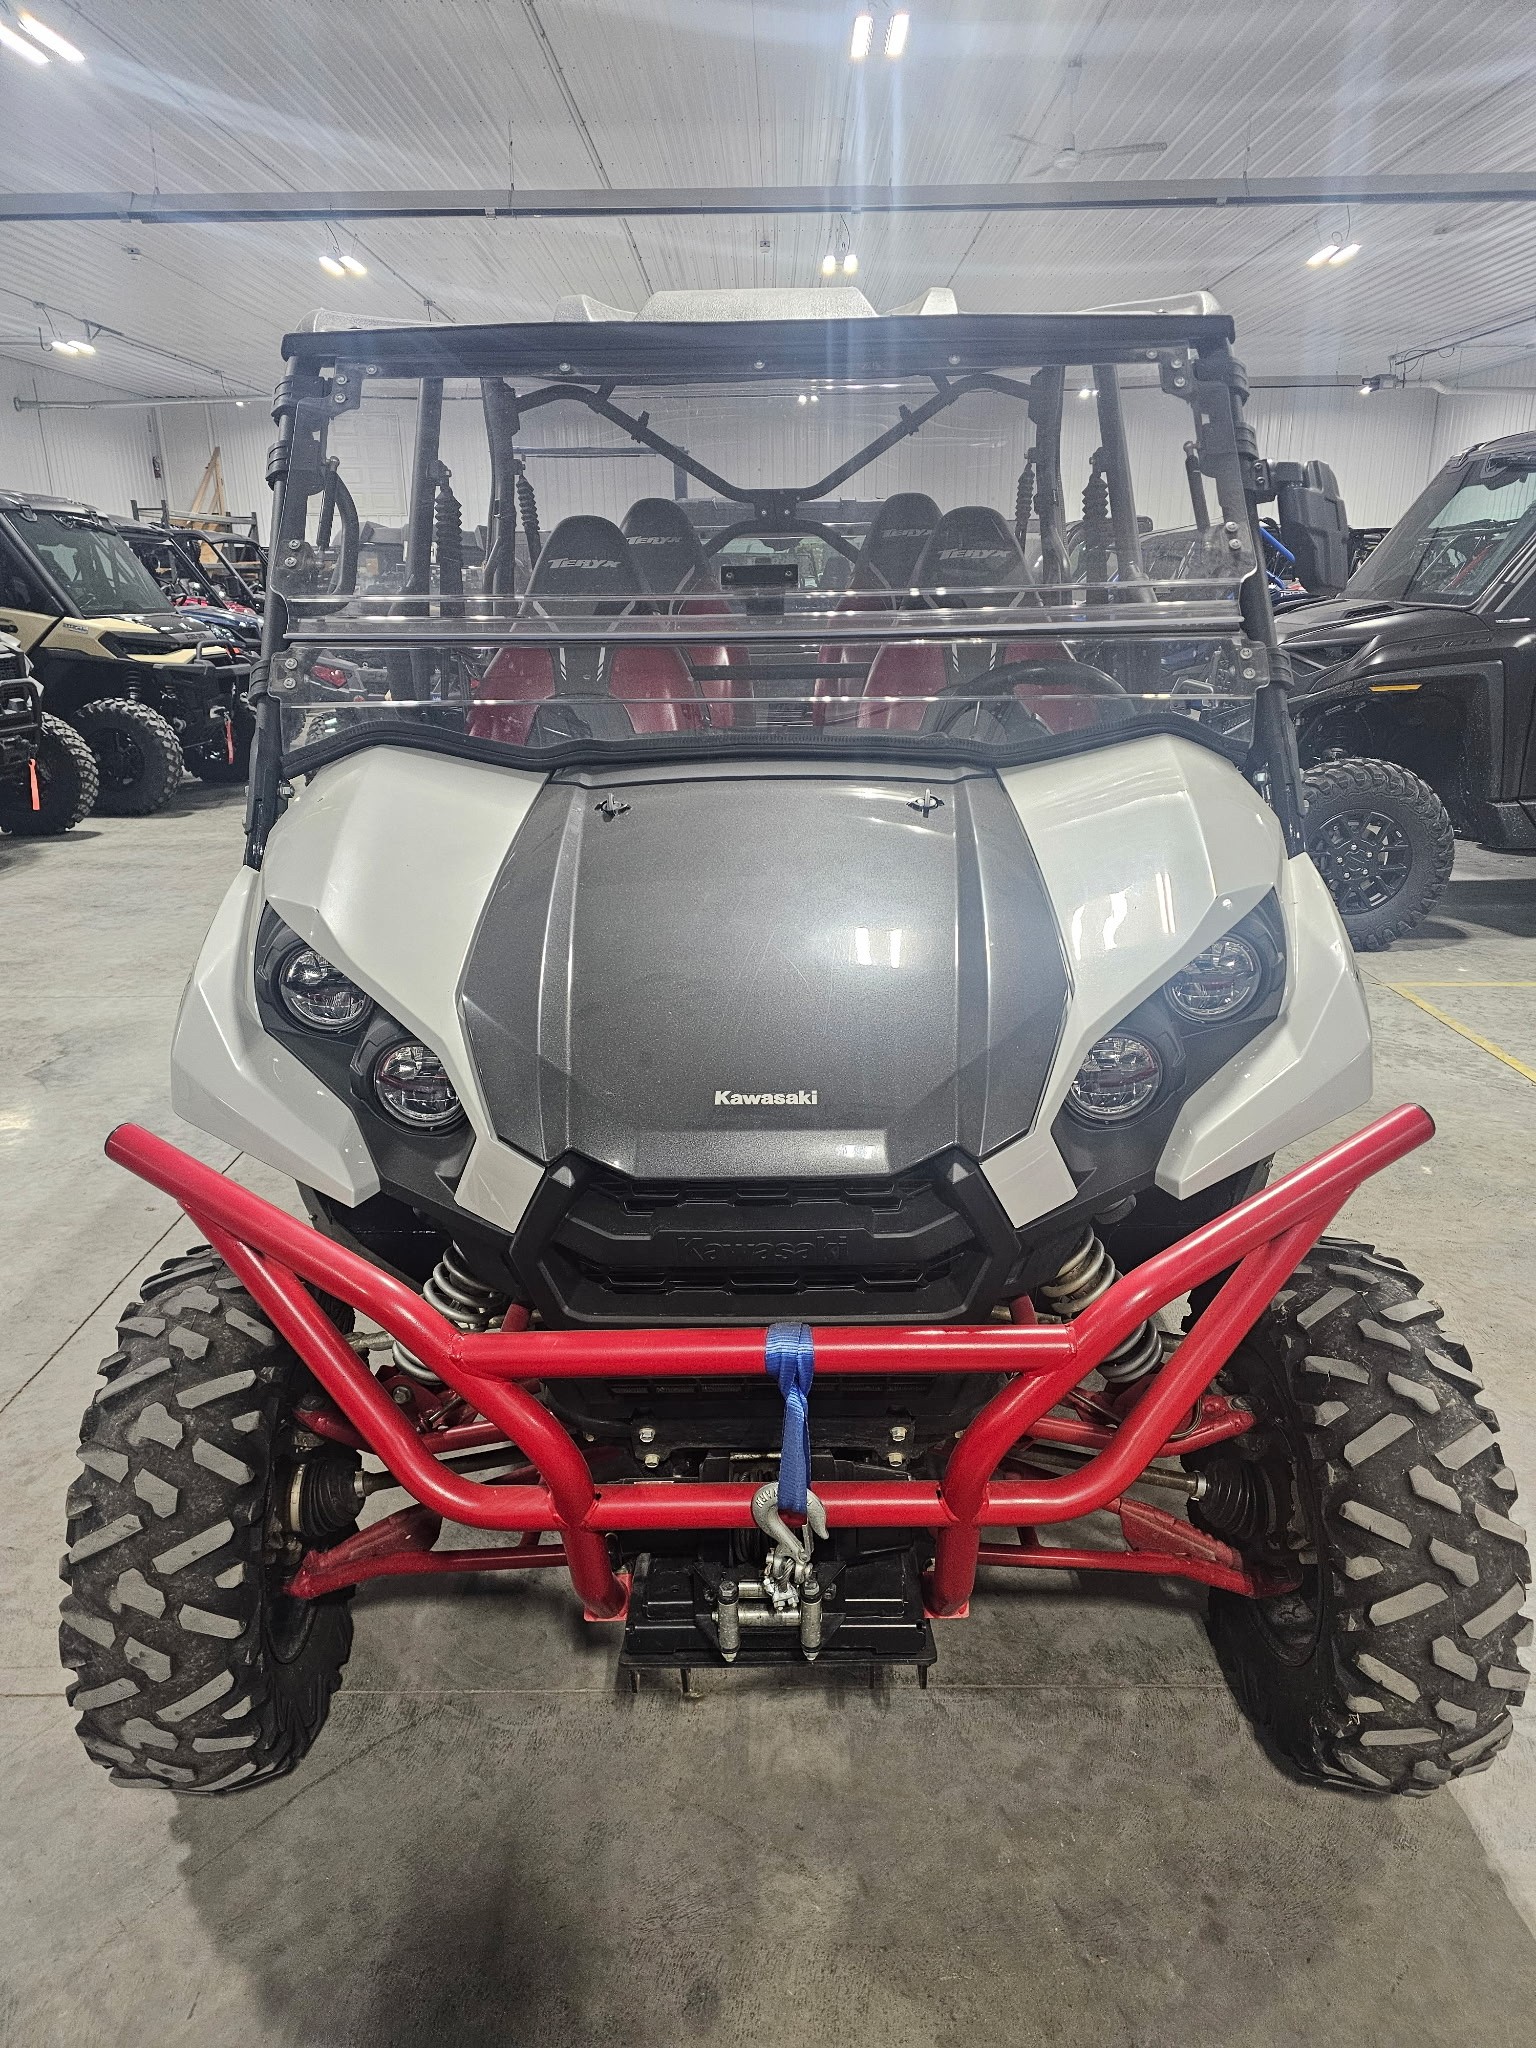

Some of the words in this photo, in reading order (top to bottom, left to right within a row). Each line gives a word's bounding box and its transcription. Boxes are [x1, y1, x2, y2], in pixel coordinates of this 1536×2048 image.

[937, 549, 1012, 560] TERYX
[548, 558, 622, 569] TERYX
[714, 1090, 818, 1106] Kawasaki
[677, 1234, 850, 1264] Kawasaki
